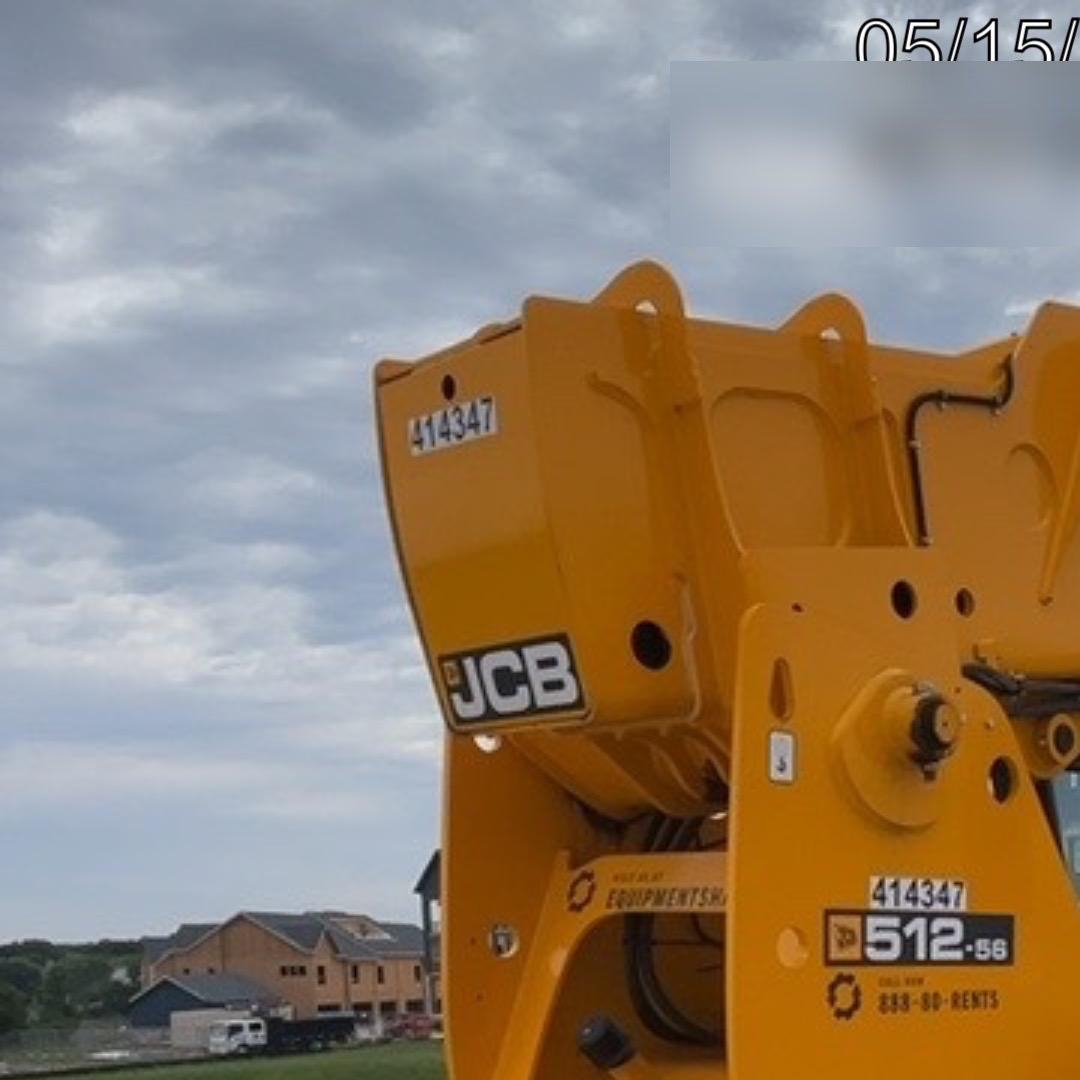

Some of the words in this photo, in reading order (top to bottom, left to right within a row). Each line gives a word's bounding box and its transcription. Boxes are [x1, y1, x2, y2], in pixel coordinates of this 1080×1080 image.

[411, 397, 494, 451] 414347
[444, 640, 580, 720] JCB
[872, 876, 964, 908] 414347
